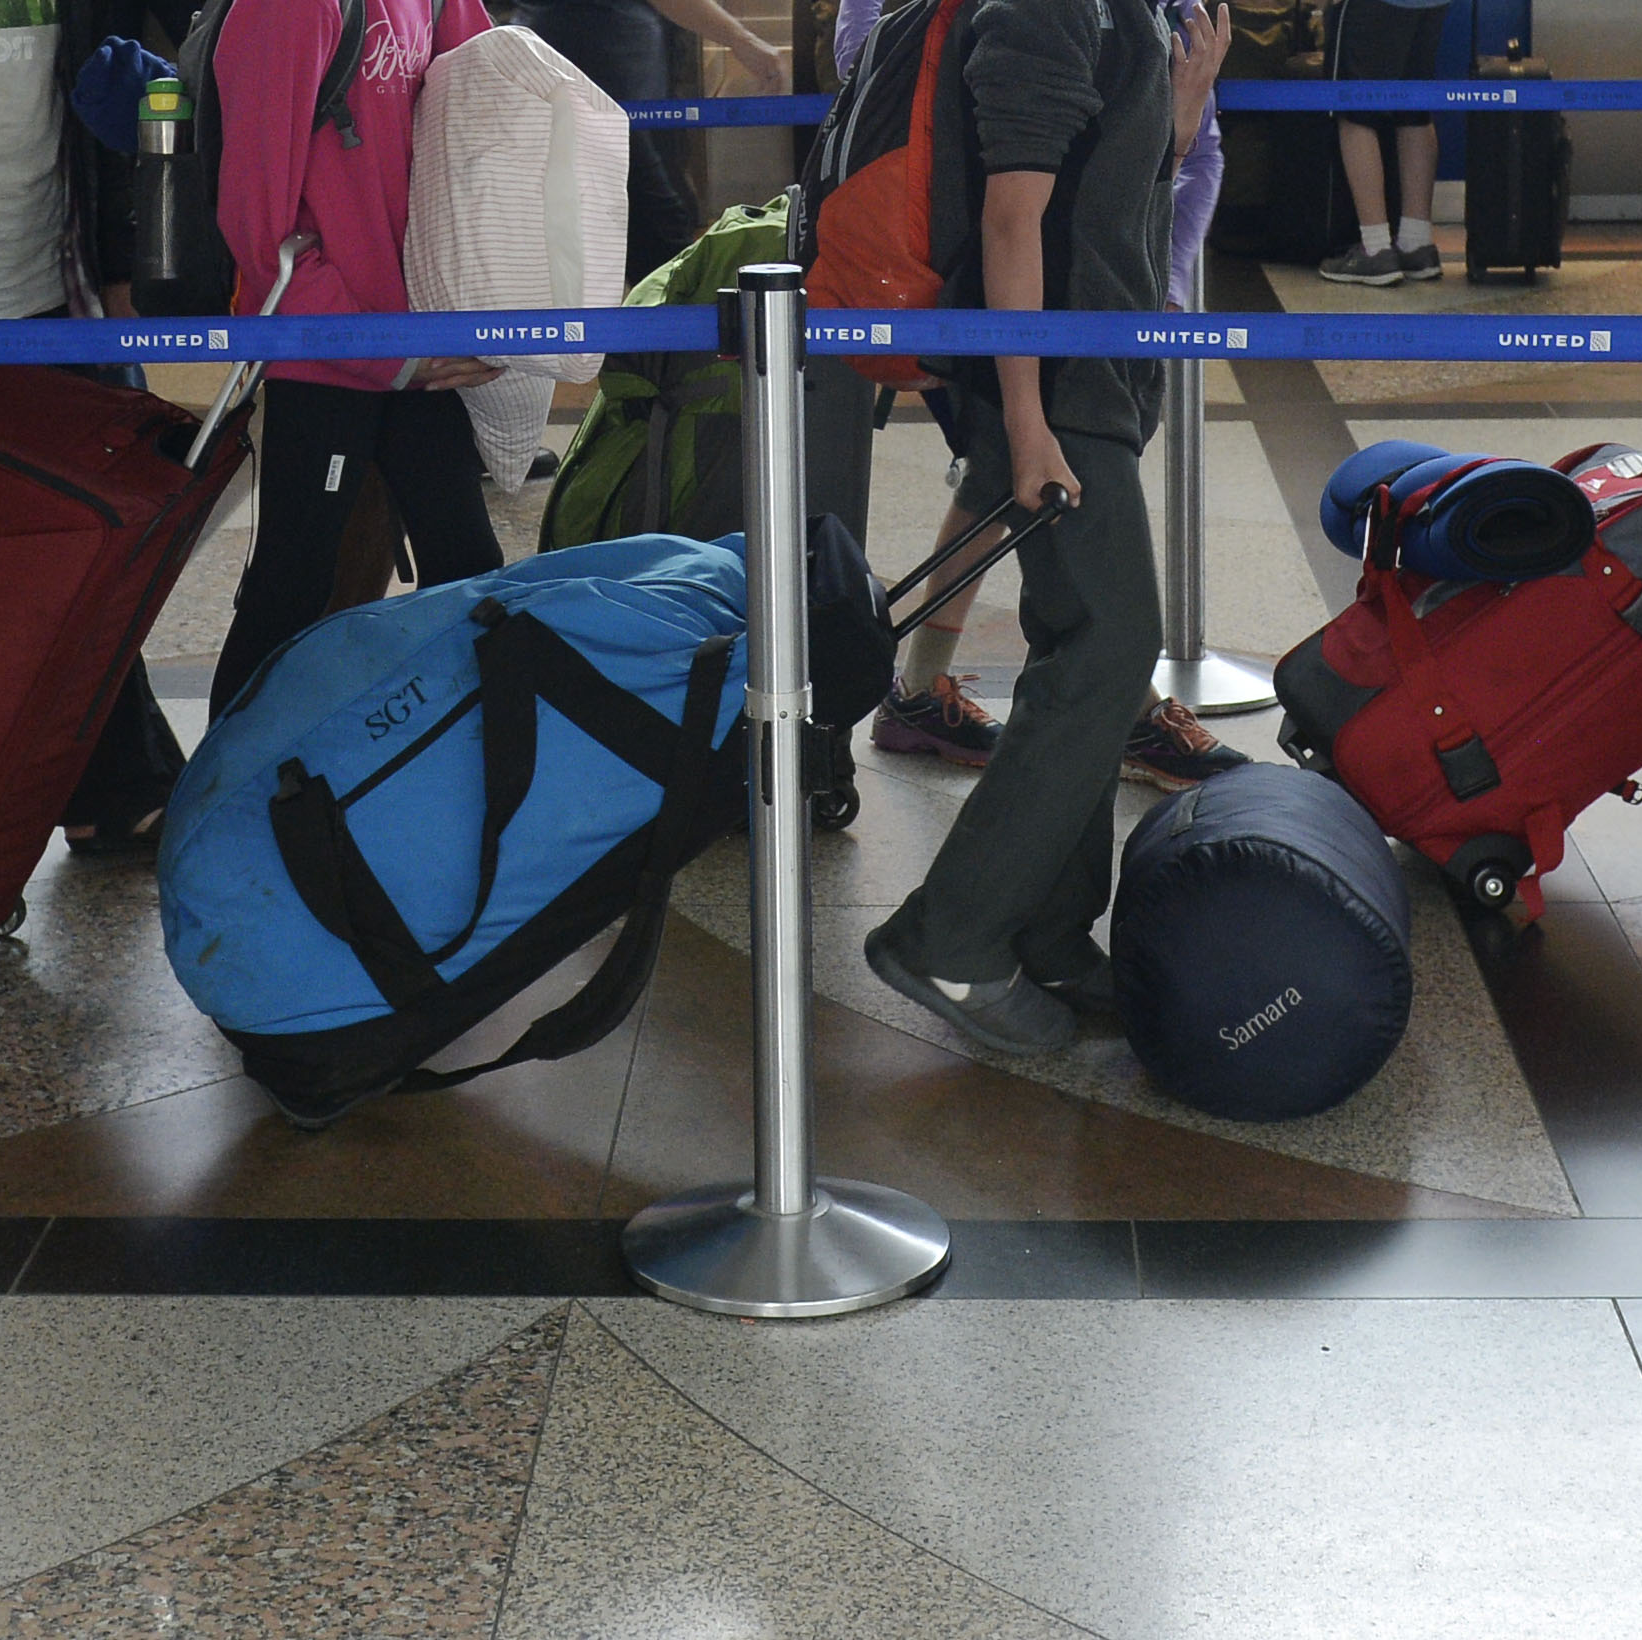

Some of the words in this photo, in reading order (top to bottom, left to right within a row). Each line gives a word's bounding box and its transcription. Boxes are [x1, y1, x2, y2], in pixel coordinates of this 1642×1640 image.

[1446, 92, 1501, 102] UNITED
[628, 110, 683, 120] UNITED
[475, 326, 559, 340] UNITED
[1136, 330, 1222, 345] UNITED
[120, 334, 203, 348] UNITED
[1498, 333, 1585, 348] UNITED
[365, 676, 428, 741] SGT
[1219, 987, 1303, 1051] Samara
